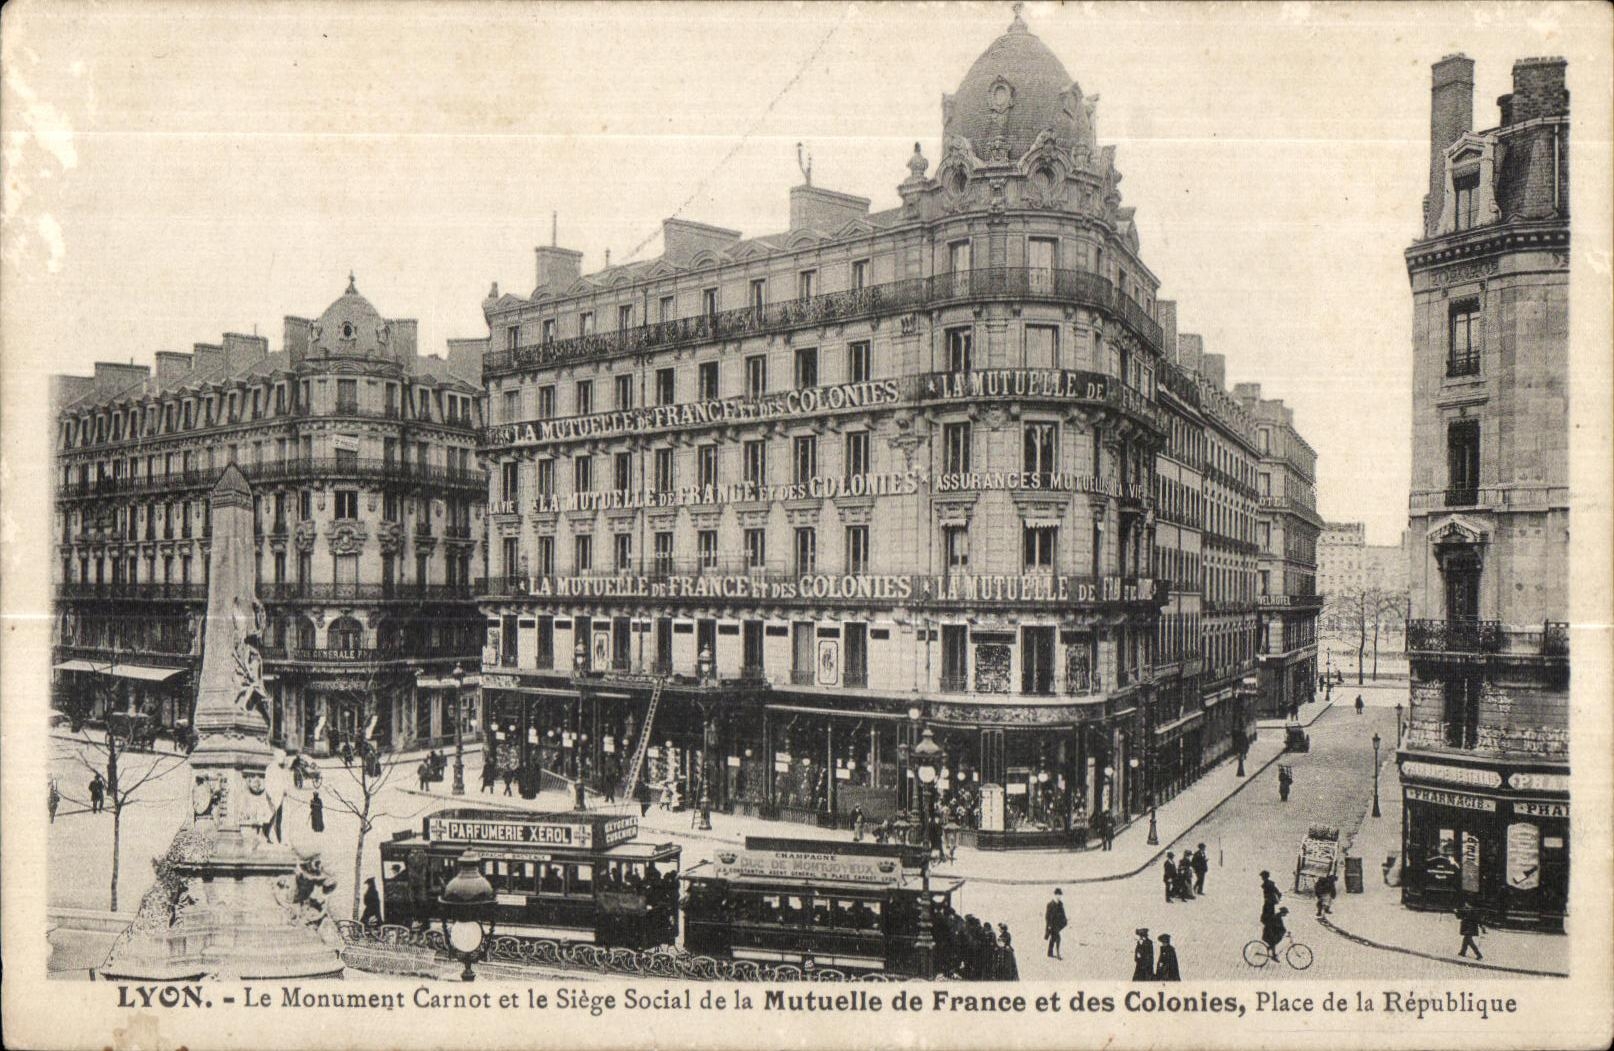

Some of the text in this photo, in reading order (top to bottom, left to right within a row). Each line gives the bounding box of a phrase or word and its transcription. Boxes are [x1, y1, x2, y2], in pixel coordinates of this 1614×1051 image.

[942, 374, 964, 398] LA
[972, 371, 1077, 397] MUTUELLE
[1087, 382, 1104, 400] DE
[513, 380, 899, 444] LA MUTUELLE DE FRANCE ET DES COLONIES
[935, 472, 1041, 490] ASSURANCES
[539, 471, 918, 513] LA MUTUELLE DE FRANCE ET DES COLONIES
[1259, 496, 1289, 507] OTEL
[529, 575, 911, 598] LA MUTUELLE DE FRANCE ET DES COLONIES
[937, 576, 959, 600] LA
[965, 576, 1069, 600] MUTUELLE
[1079, 584, 1096, 601] DE
[450, 823, 524, 841] PARFUMERIE
[741, 857, 764, 869] DUC
[771, 859, 786, 870] DE
[775, 853, 837, 862] CHAMPAGNE
